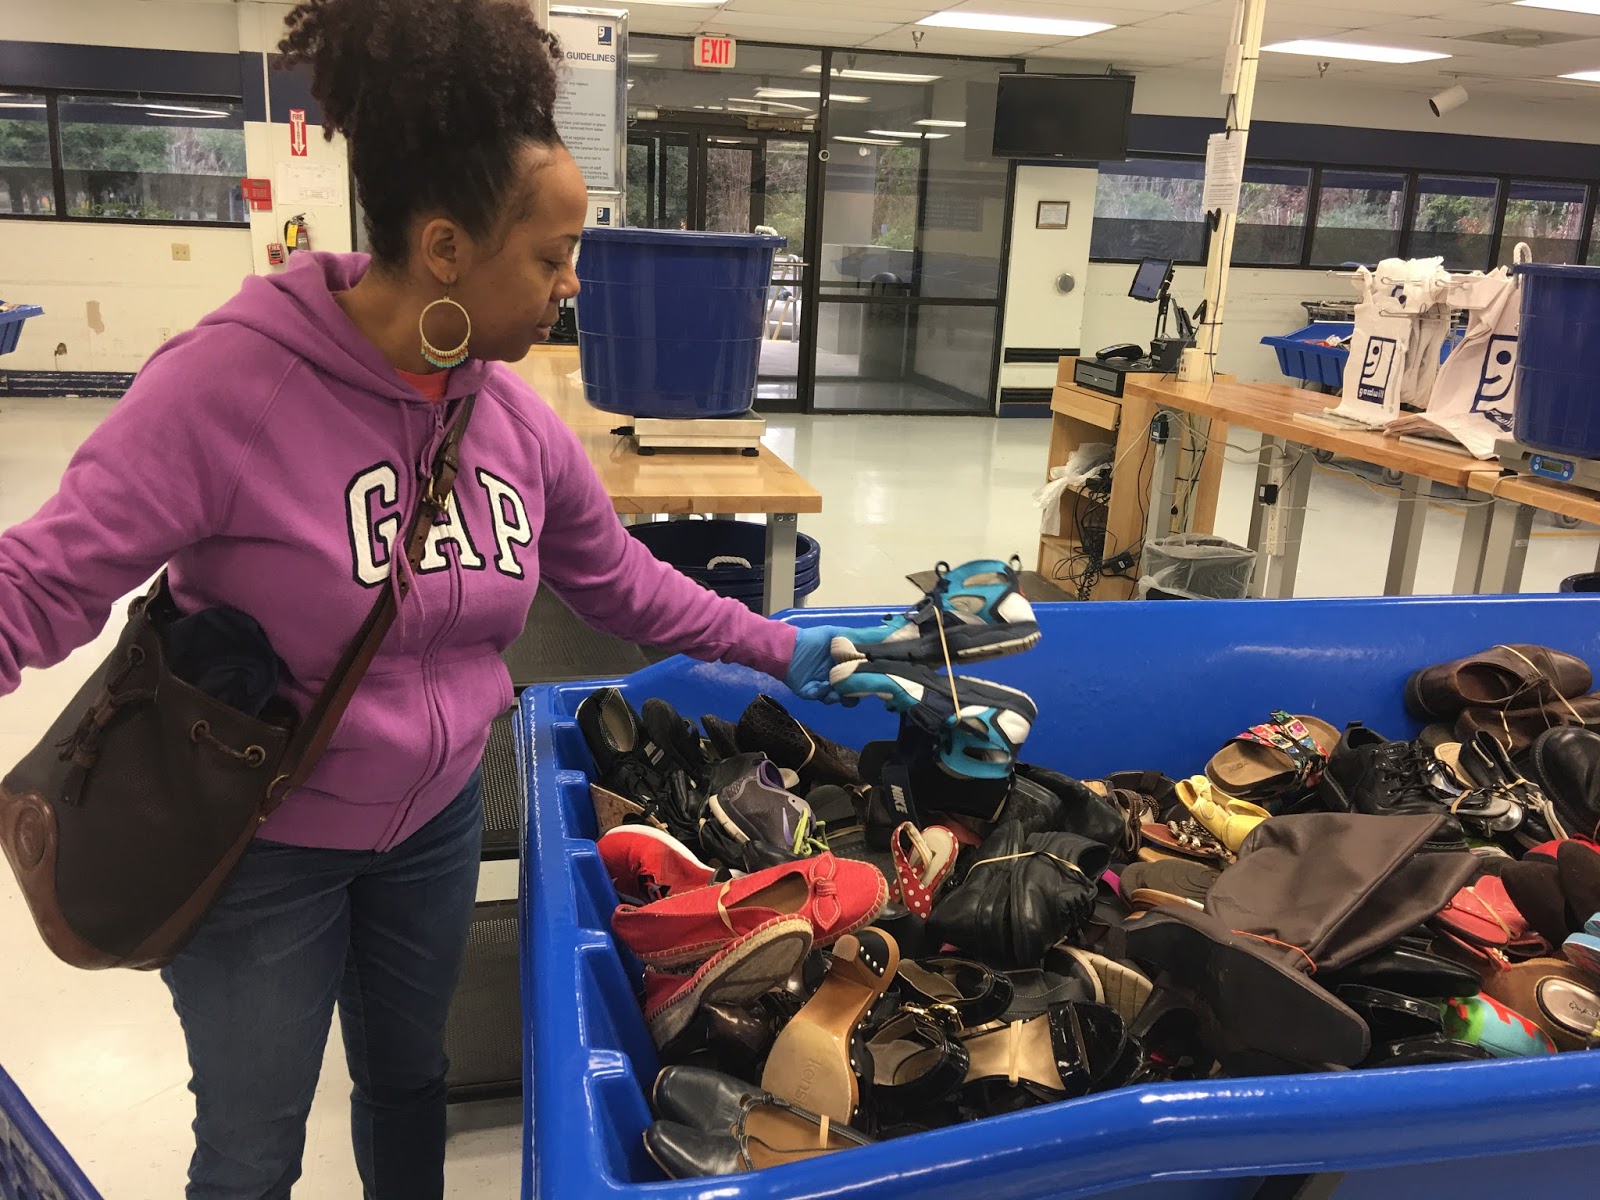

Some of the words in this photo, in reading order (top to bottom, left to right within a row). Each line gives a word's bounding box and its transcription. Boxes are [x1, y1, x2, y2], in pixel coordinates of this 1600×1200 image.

[566, 51, 616, 63] GUIDELINES
[702, 38, 731, 64] EXIT
[344, 460, 533, 589] GAP
[890, 784, 908, 815] NIKE
